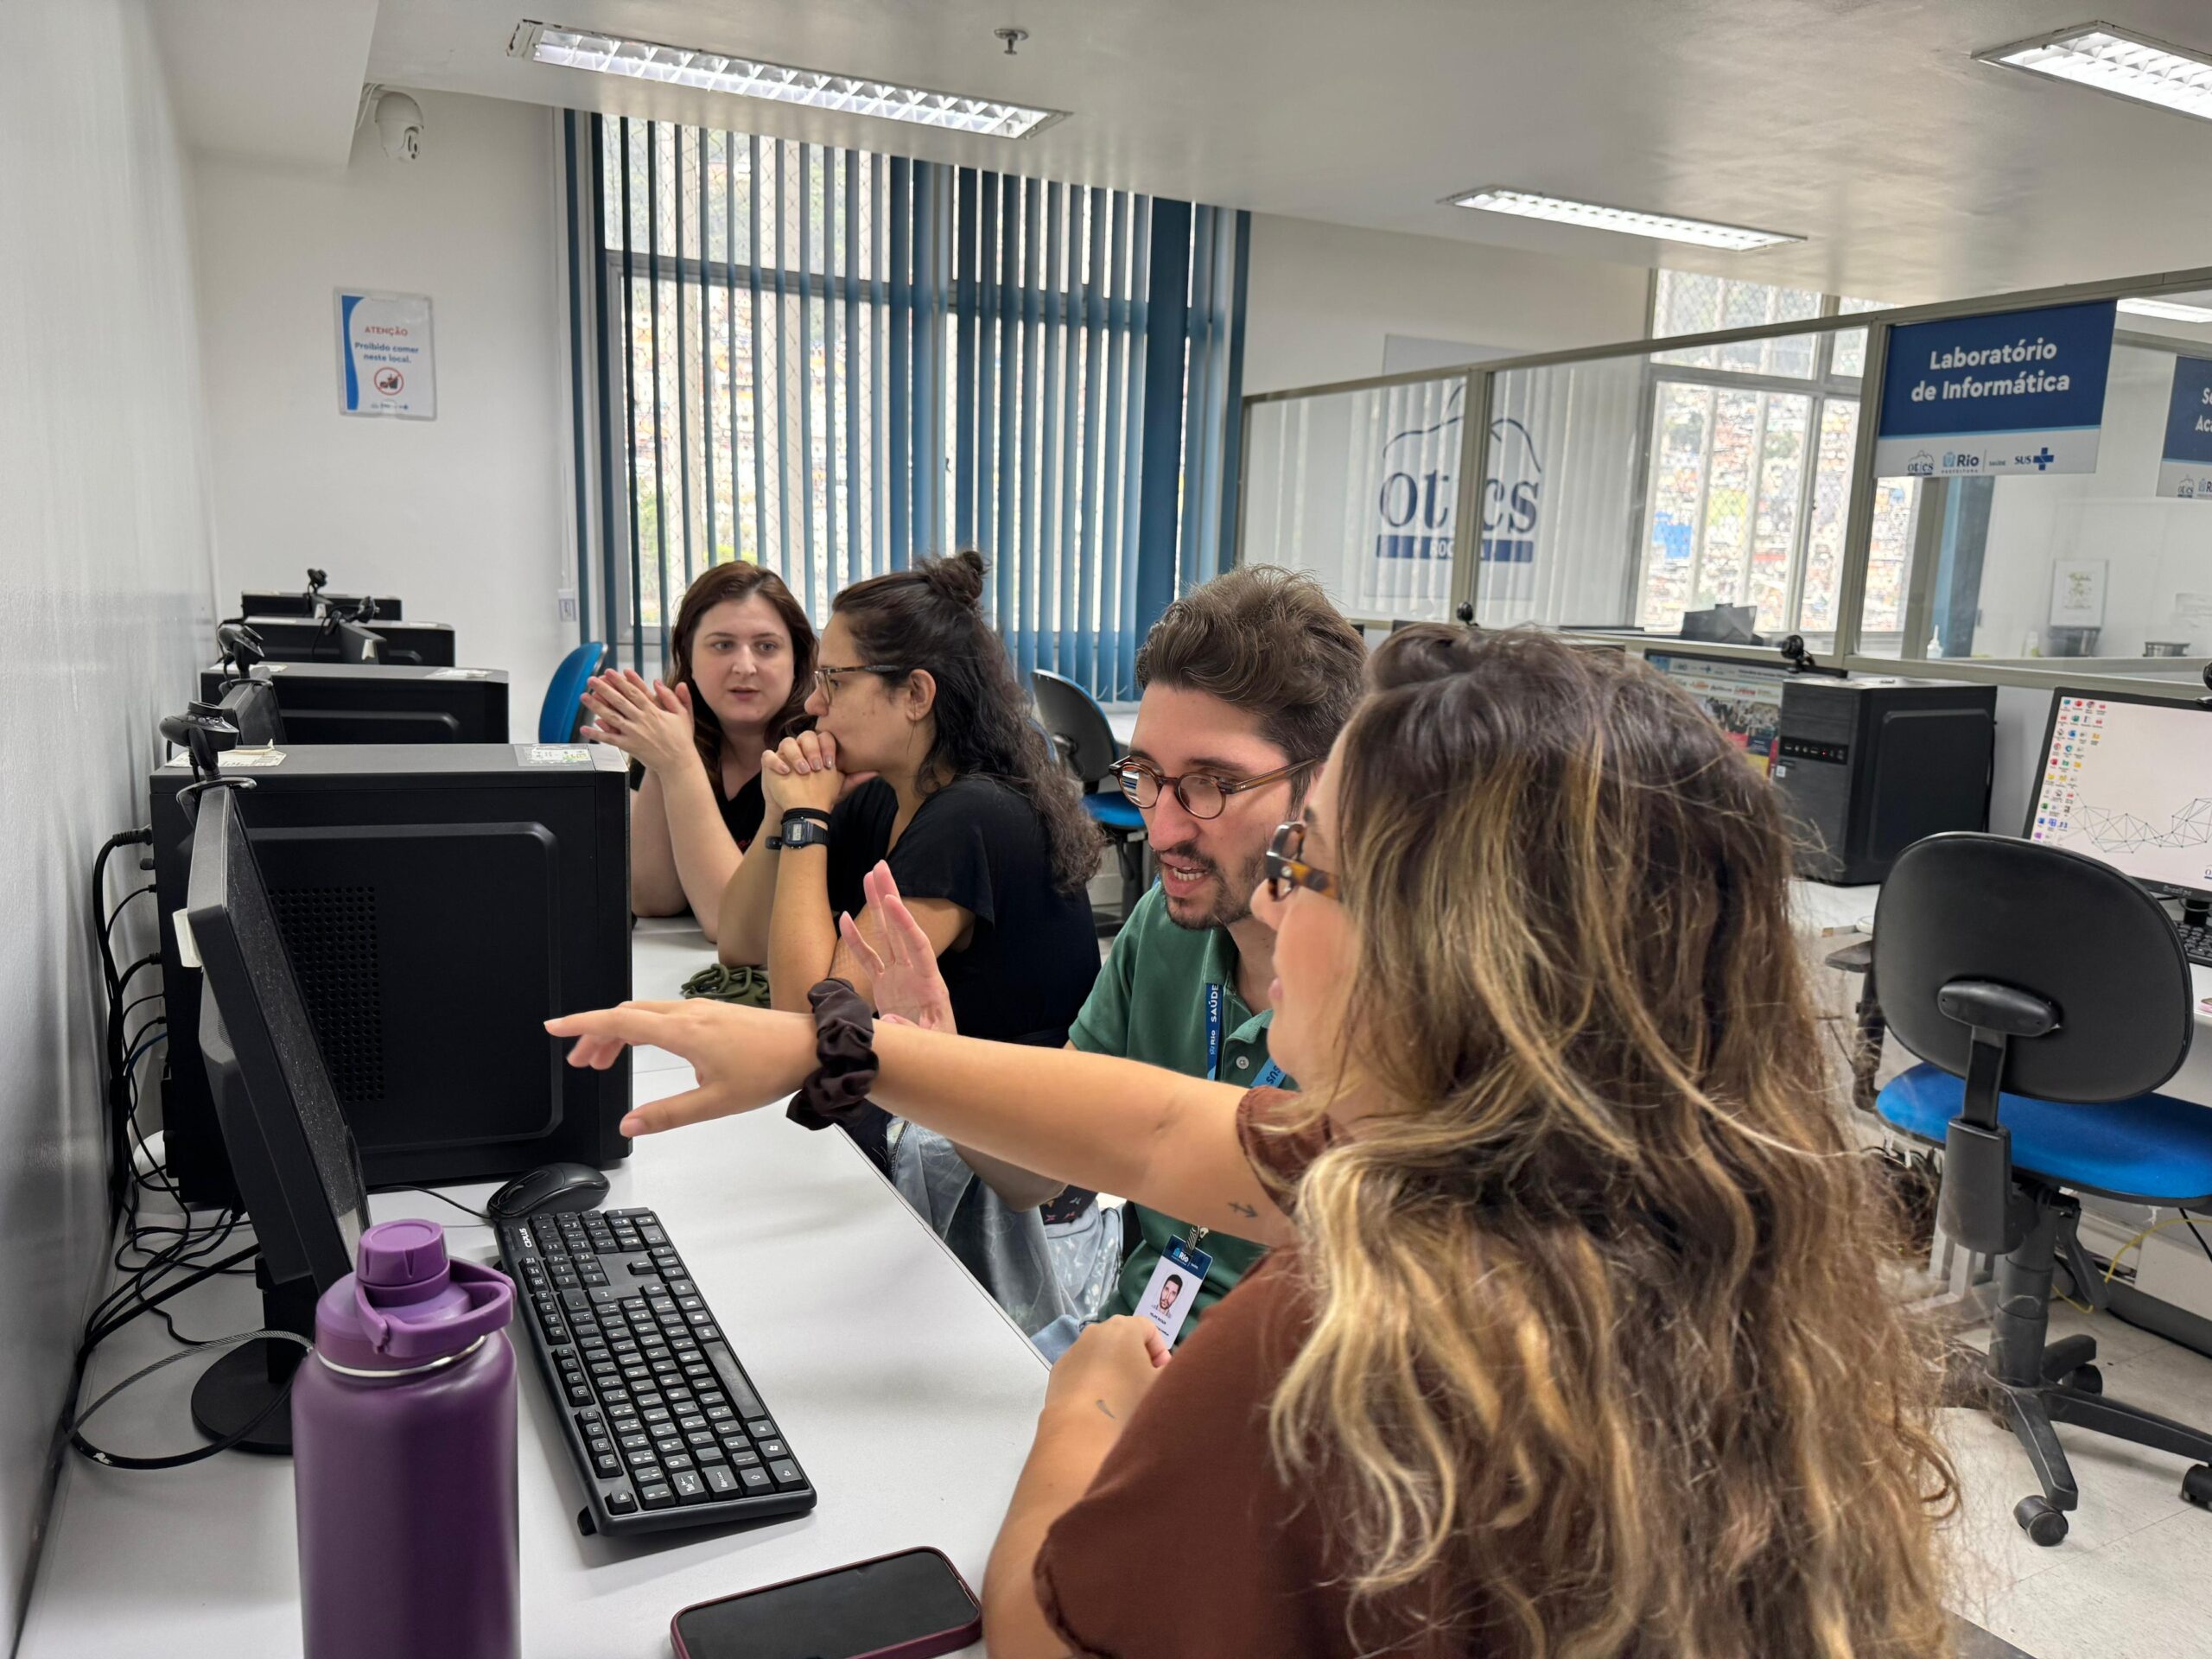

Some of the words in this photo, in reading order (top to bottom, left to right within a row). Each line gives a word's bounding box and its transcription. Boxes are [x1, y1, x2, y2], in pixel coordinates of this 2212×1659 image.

[365, 326, 408, 336] ATENÇÃO
[354, 342, 391, 351] Proibido
[389, 354, 411, 364] local.
[1929, 337, 2057, 370] Laboratório
[1910, 380, 1937, 402] de
[1942, 370, 2070, 399] Informática
[1956, 454, 1980, 467] Rio
[2014, 455, 2031, 465] SUS
[1379, 469, 1540, 534] otcs
[1208, 983, 1219, 1023] SAÚDE
[1266, 1065, 1281, 1085] SUS
[1178, 1251, 1189, 1263] Rio
